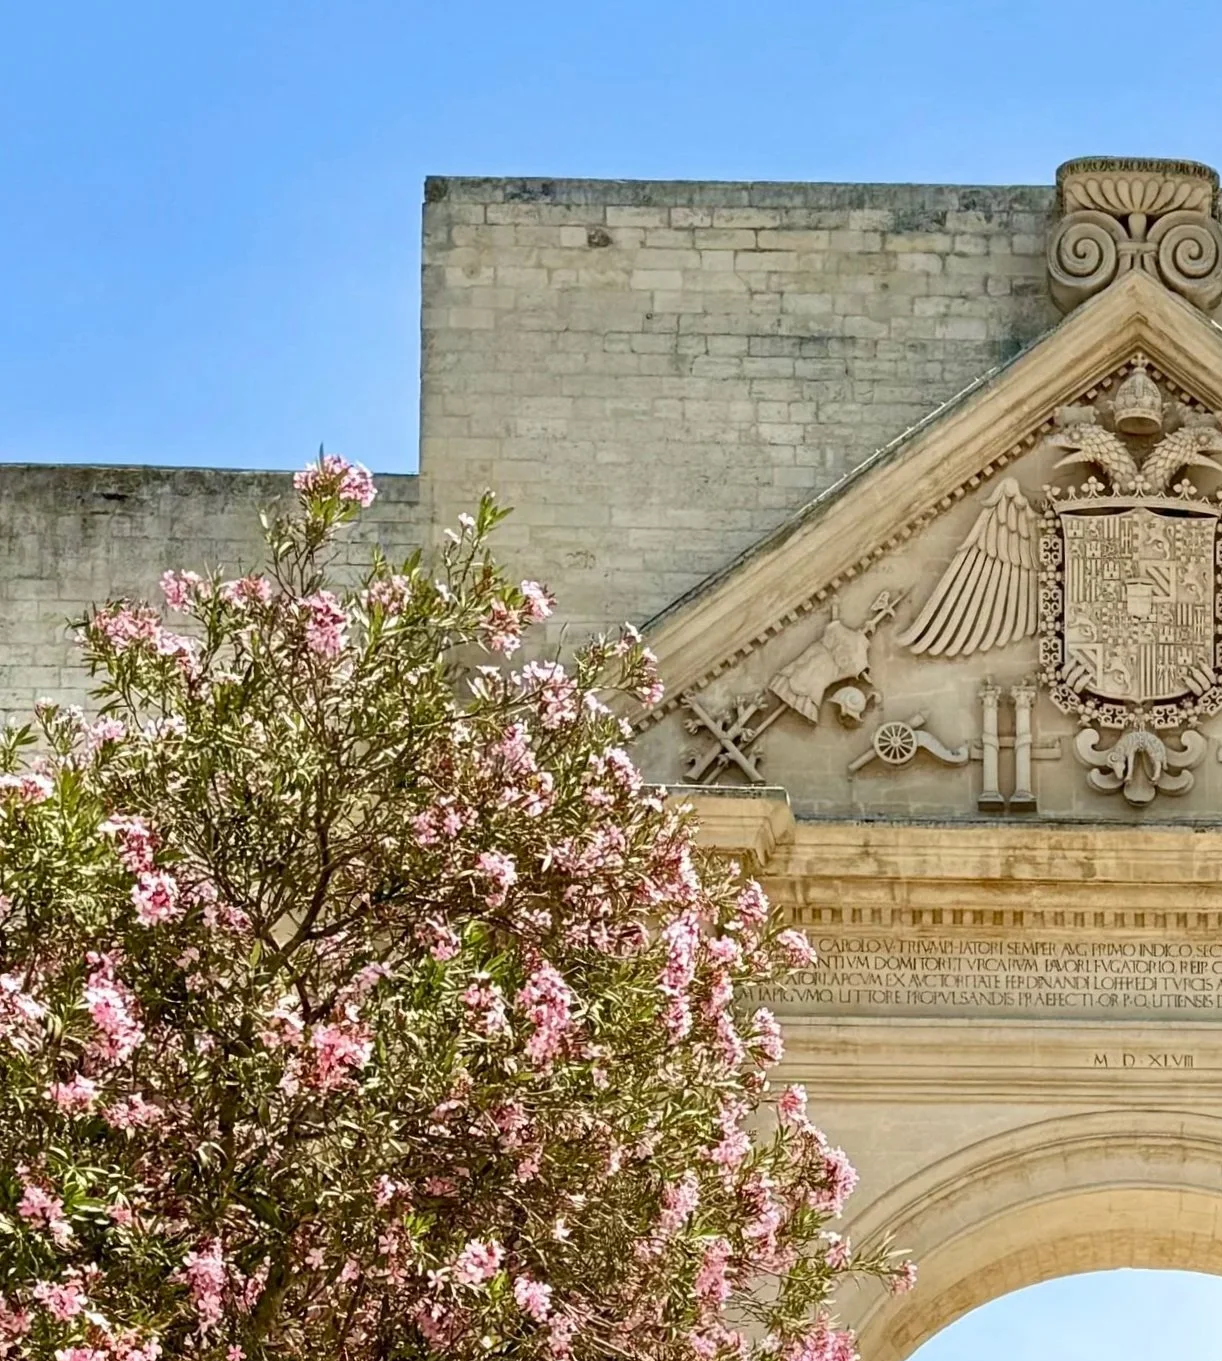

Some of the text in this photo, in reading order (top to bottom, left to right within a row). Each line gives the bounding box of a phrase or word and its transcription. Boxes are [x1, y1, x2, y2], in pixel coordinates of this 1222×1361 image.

[819, 938, 881, 953] CAROLO
[1007, 941, 1056, 956] SEMPER
[1092, 943, 1136, 957] PRIMO
[886, 973, 905, 987] EX
